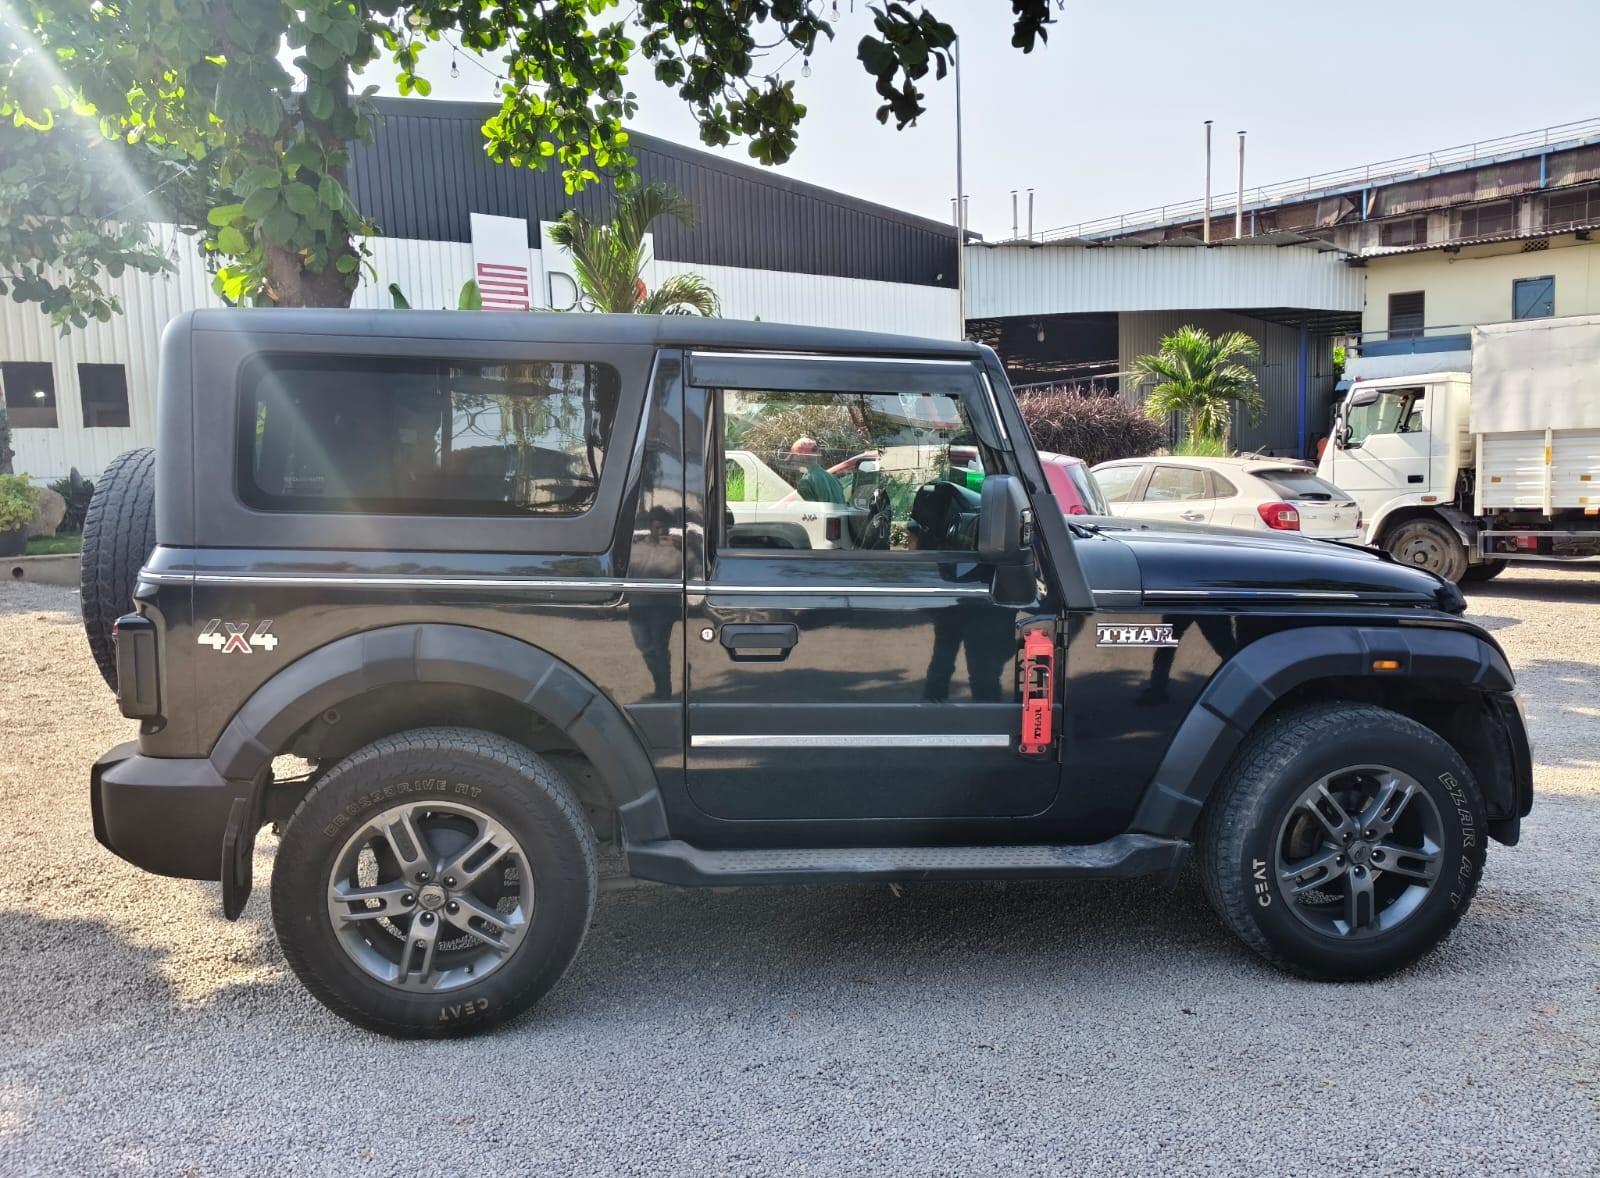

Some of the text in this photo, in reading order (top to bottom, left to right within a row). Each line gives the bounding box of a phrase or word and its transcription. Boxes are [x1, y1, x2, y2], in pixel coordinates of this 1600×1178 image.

[1096, 625, 1179, 646] THAR
[1252, 858, 1271, 907] CEAT
[439, 998, 489, 1021] CEAT
